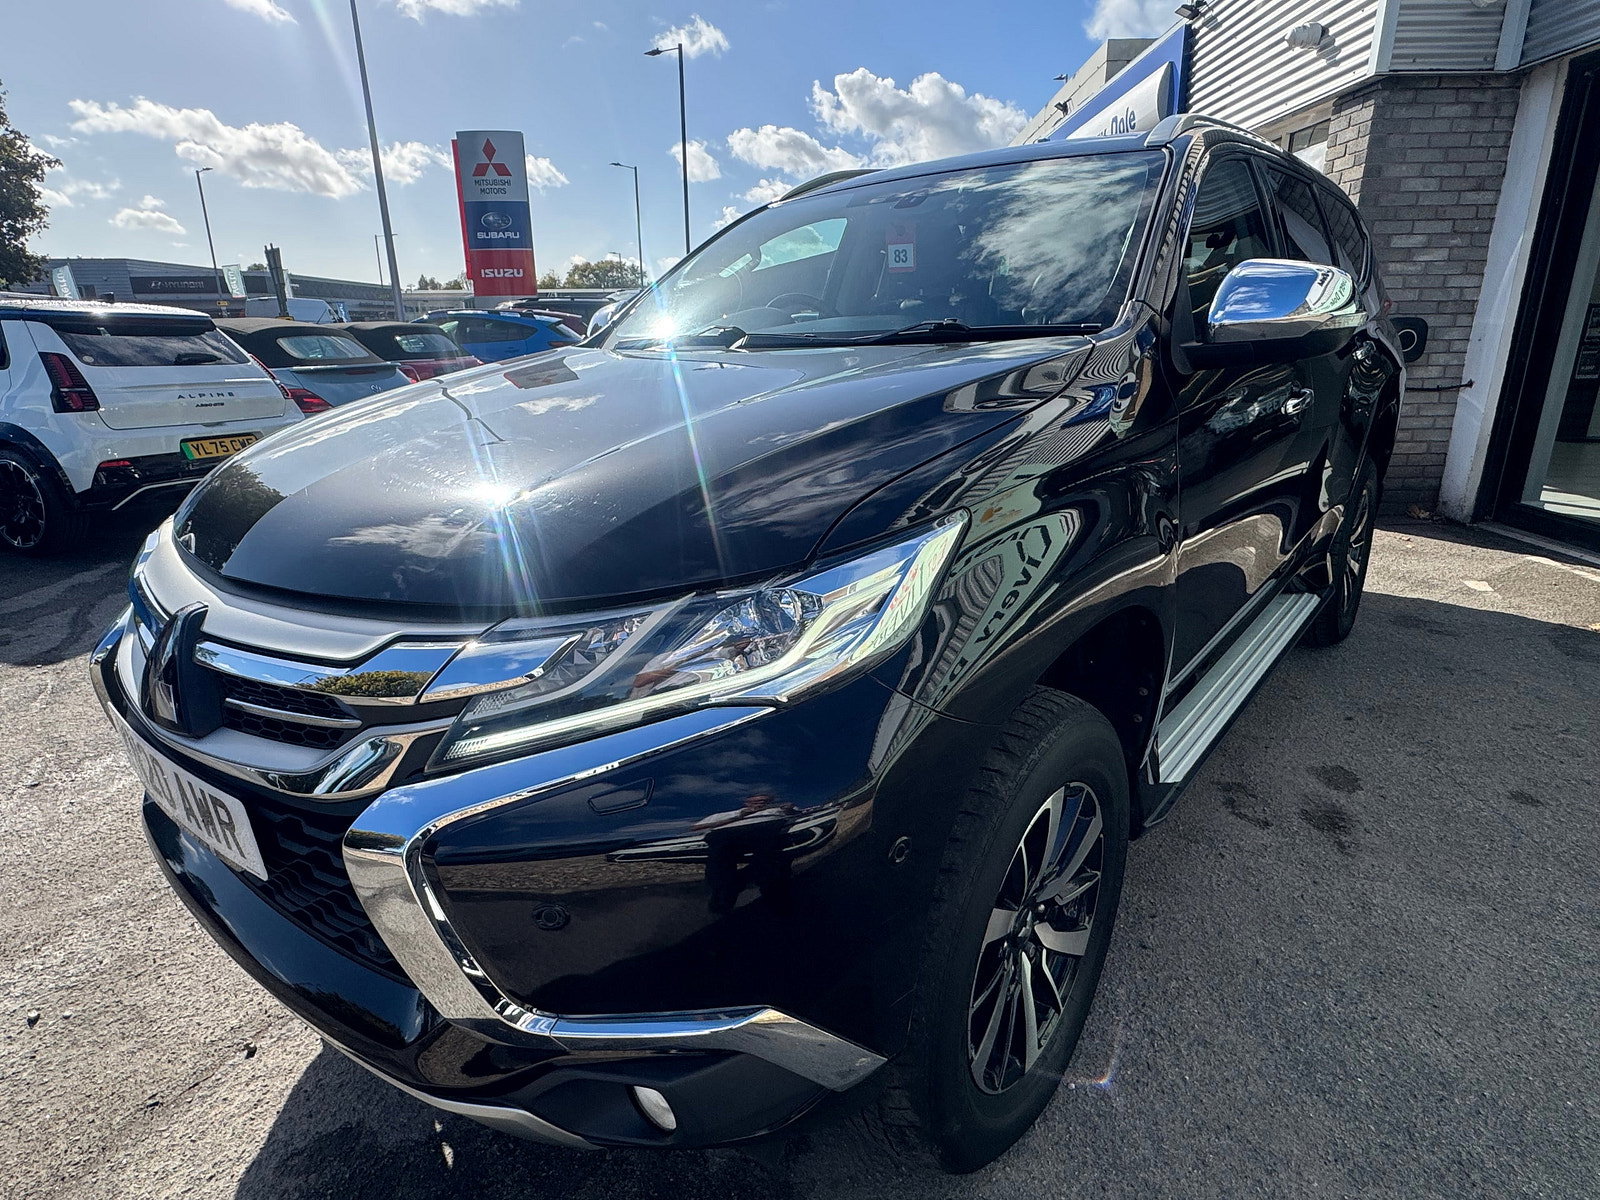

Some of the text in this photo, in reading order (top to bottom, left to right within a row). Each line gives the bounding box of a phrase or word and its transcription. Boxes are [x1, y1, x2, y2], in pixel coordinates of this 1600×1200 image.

[474, 179, 512, 187] MITSUBISHI
[479, 187, 507, 195] MOTORS
[476, 231, 520, 239] SUBARU
[894, 249, 907, 263] 83
[480, 268, 524, 278] ISUZU
[162, 281, 205, 289] HYUNDAI
[177, 391, 235, 400] ALPINE
[190, 440, 229, 456] YL75
[173, 771, 247, 860] AWR
